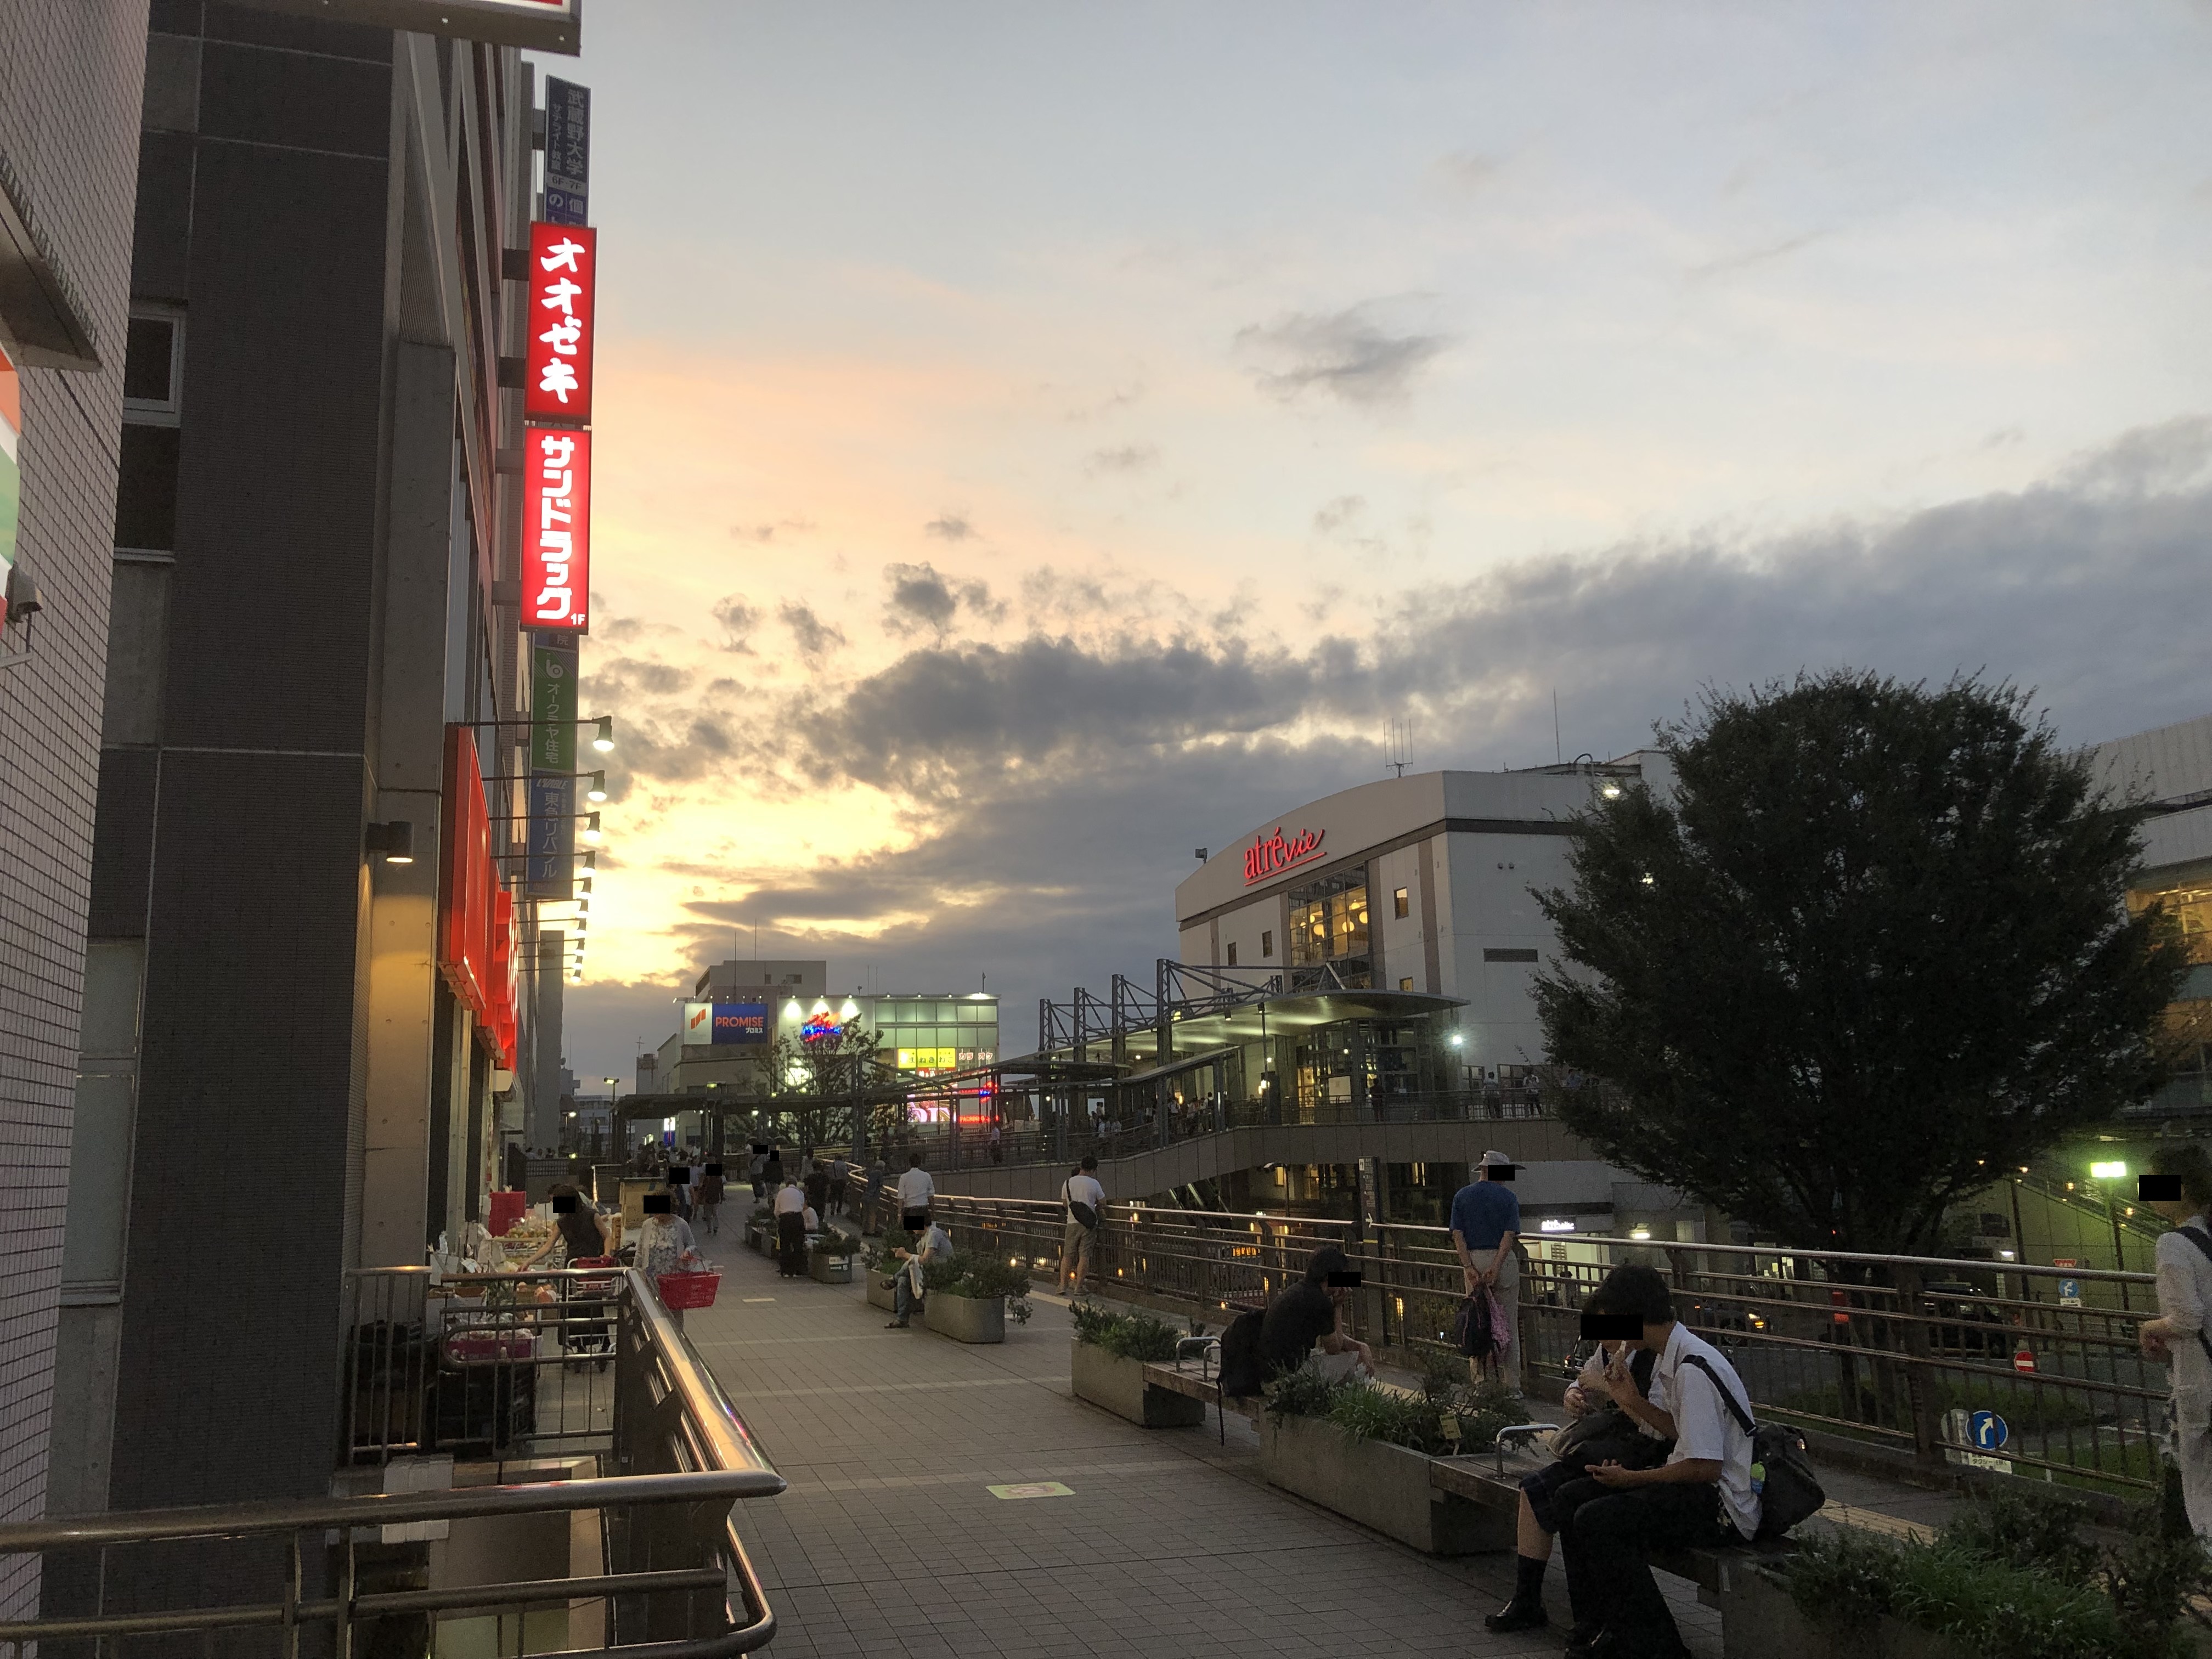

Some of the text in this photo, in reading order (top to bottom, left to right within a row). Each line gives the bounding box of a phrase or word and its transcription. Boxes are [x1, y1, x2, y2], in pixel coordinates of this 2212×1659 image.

[566, 89, 584, 175] 武蔵野大学
[539, 237, 585, 404] オオゼキ
[536, 435, 575, 620] サンドラッグ
[571, 613, 586, 625] 1F
[543, 792, 560, 878] 東急リバブル
[715, 1016, 764, 1027] PROMISE
[958, 1052, 993, 1060] カラオケ
